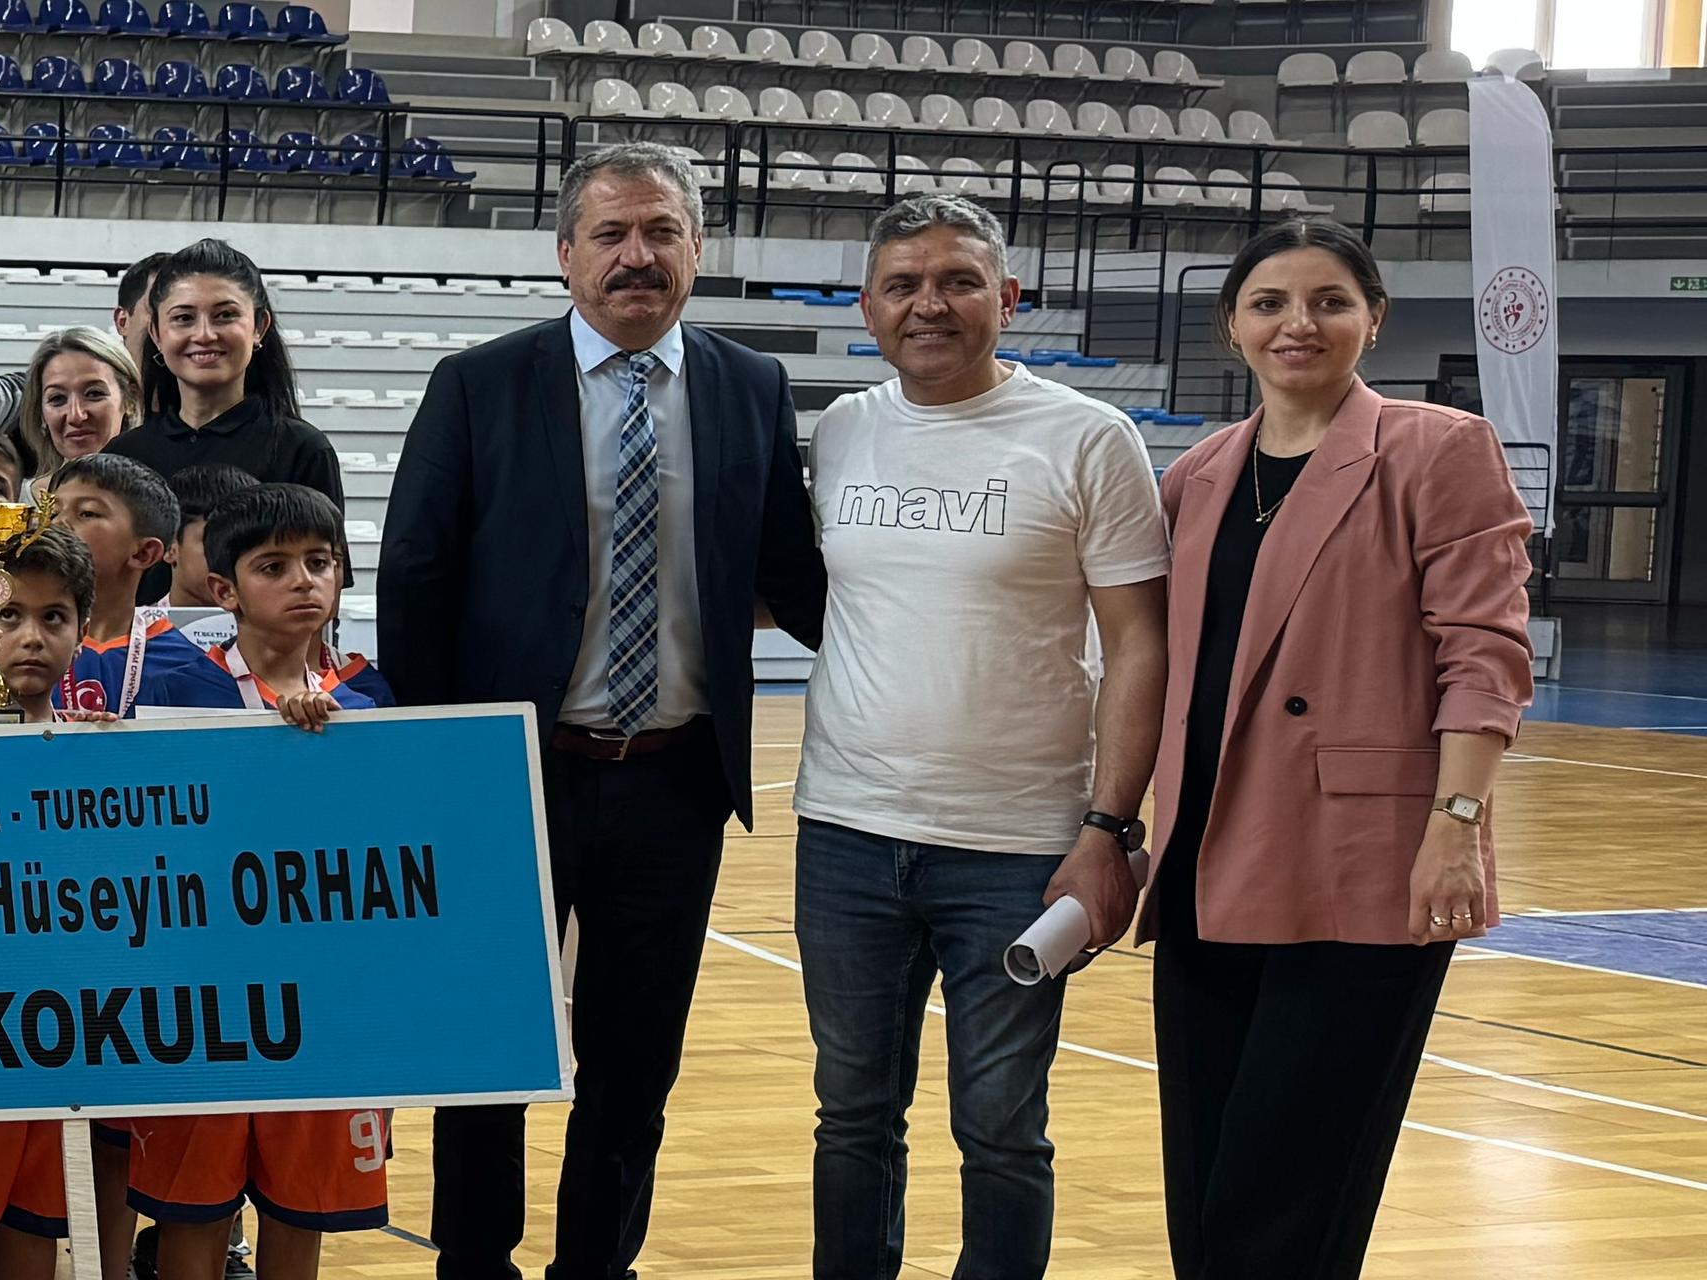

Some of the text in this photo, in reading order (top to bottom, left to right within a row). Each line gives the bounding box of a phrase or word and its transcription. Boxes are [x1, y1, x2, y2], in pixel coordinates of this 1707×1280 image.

[838, 478, 1008, 536] mavi
[31, 782, 211, 832] TURGUTLU
[232, 844, 441, 928] ORHAN
[349, 1110, 384, 1173] 9
